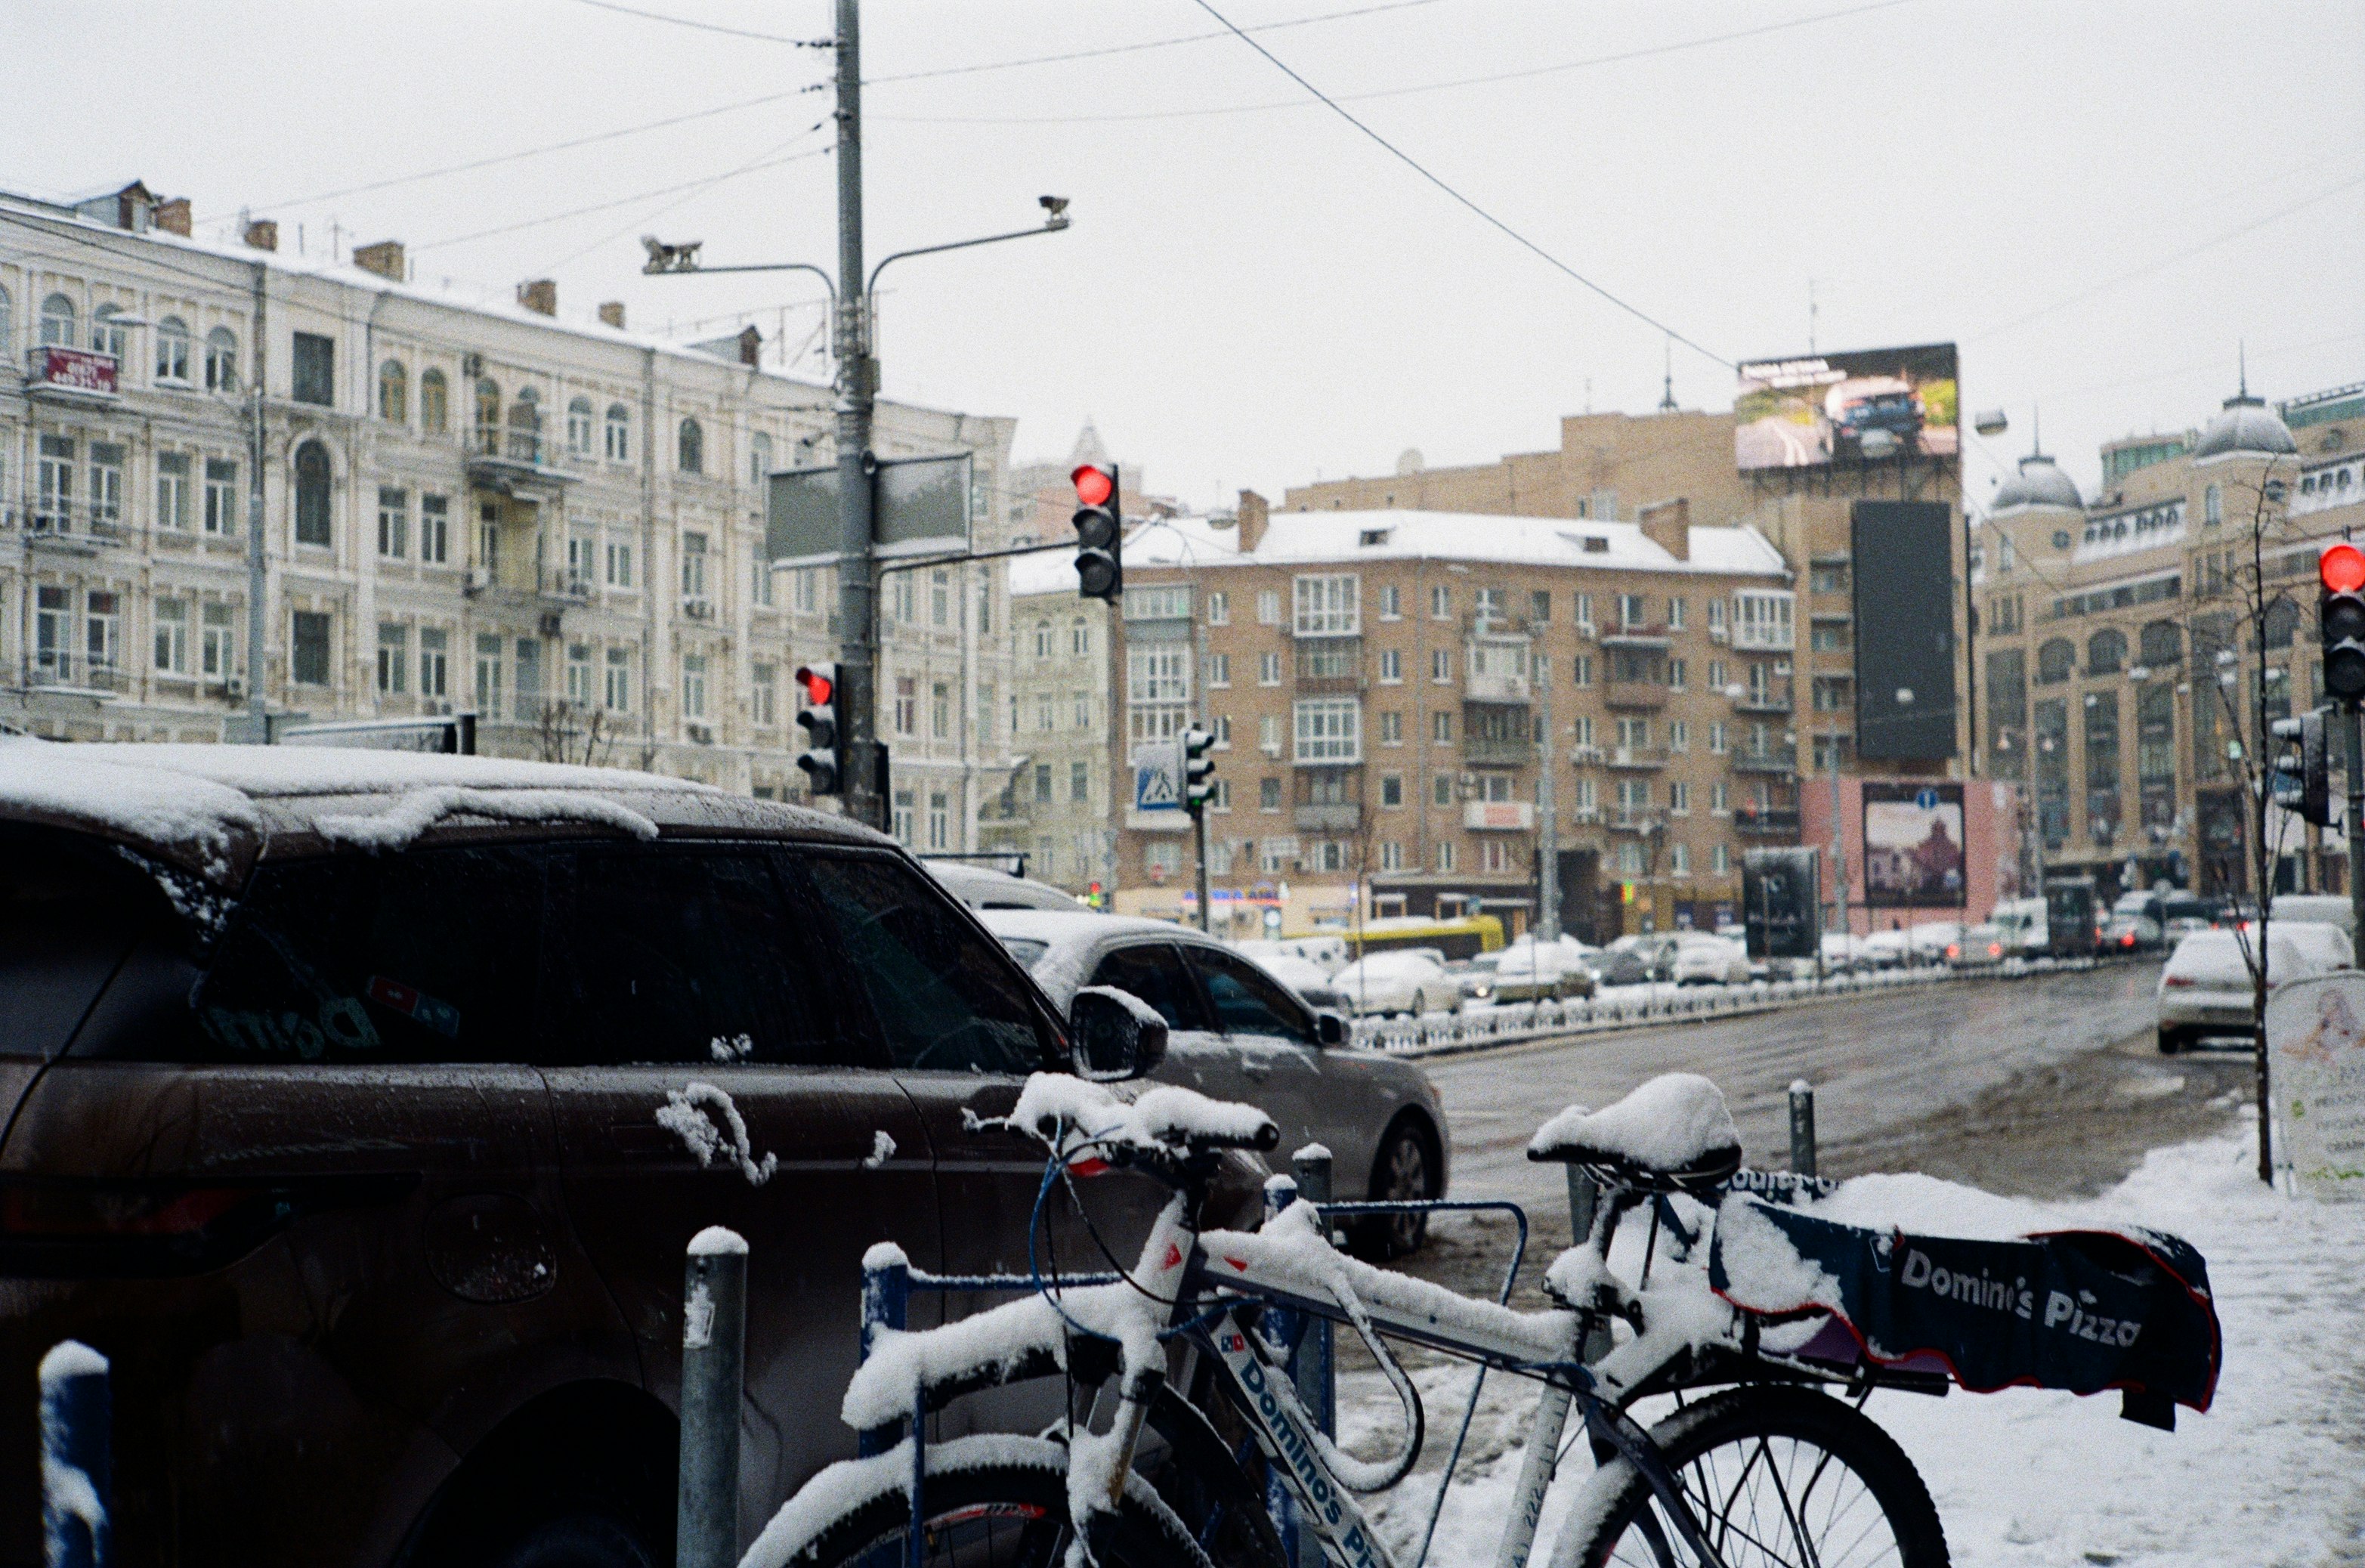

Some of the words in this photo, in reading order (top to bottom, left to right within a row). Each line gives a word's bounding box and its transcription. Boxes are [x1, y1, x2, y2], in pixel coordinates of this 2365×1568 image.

[1901, 1248, 2034, 1320] Domino's
[2044, 1289, 2142, 1348] Pizza
[1240, 1356, 1343, 1525] Domino's
